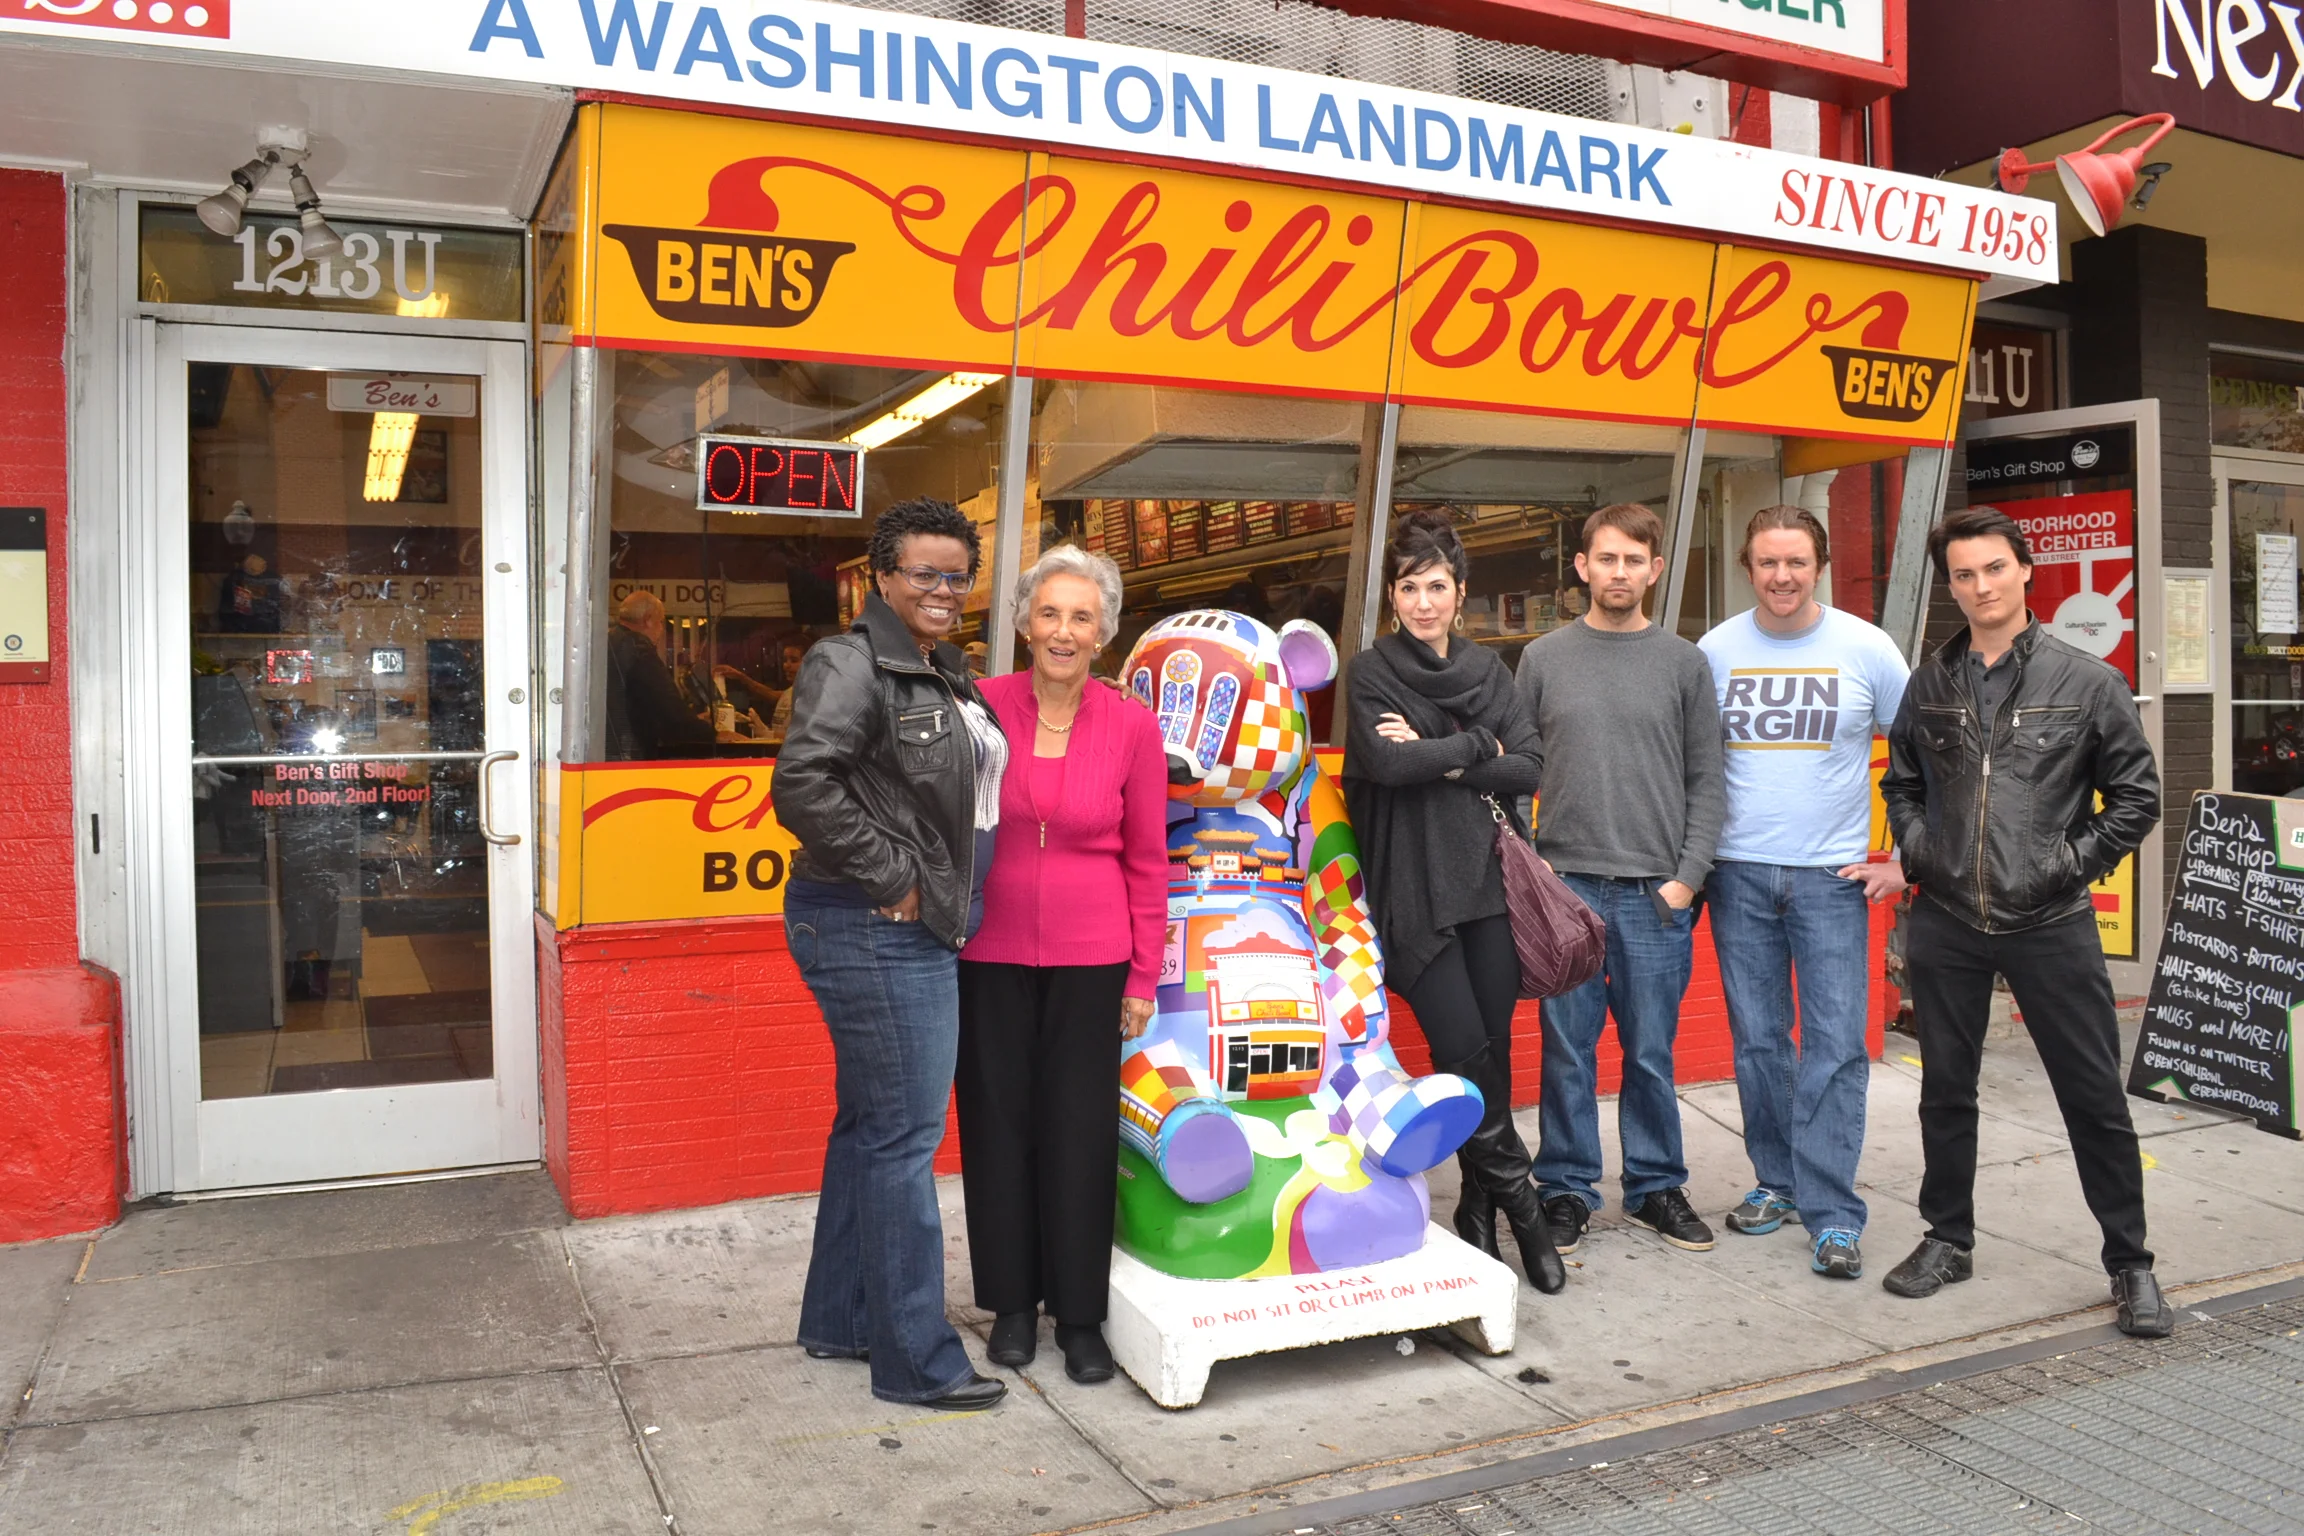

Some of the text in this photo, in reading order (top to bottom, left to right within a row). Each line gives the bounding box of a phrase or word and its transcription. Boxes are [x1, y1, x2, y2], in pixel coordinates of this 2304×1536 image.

[468, 0, 1673, 206] A WASHINGTON LANDMARK
[1774, 168, 2048, 266] SINCE 1958
[386, 230, 442, 302] U
[656, 239, 814, 312] BEN'S
[945, 173, 1805, 389] Chili Bowl
[1843, 356, 1934, 412] BEN'S
[2002, 345, 2033, 408] U
[365, 380, 441, 408] Ben's
[707, 445, 856, 508] OPEN
[1966, 460, 2066, 481] Ben's Gift Shop
[2014, 511, 2116, 535] BORHOOD
[2040, 531, 2117, 552] CENTER
[2050, 552, 2081, 561] STREET
[411, 580, 445, 601] OF
[676, 584, 725, 604] DOG
[1723, 677, 1839, 707] RUN
[1722, 709, 1839, 741] RGIII
[275, 761, 408, 781] Ben's Gift Shop
[251, 785, 431, 807] Next Door, 2nd Floor!
[2195, 794, 2265, 842] Ben's
[2186, 830, 2276, 873] GIFT SHOP
[703, 849, 797, 892] BO
[2249, 873, 2276, 889] OPEN
[2277, 880, 2284, 892] 7
[2193, 966, 2244, 996] SMOKES
[2214, 991, 2251, 1020] home)
[2200, 1019, 2224, 1035] and
[2214, 1050, 2274, 1081] TWITTER
[1192, 1315, 1216, 1329] DO
[1266, 1302, 1292, 1318] SIT
[1298, 1298, 1328, 1314] OR
[1329, 1288, 1386, 1309] CLIMB
[1391, 1281, 1416, 1299] ON
[1423, 1276, 1479, 1294] PANDA
